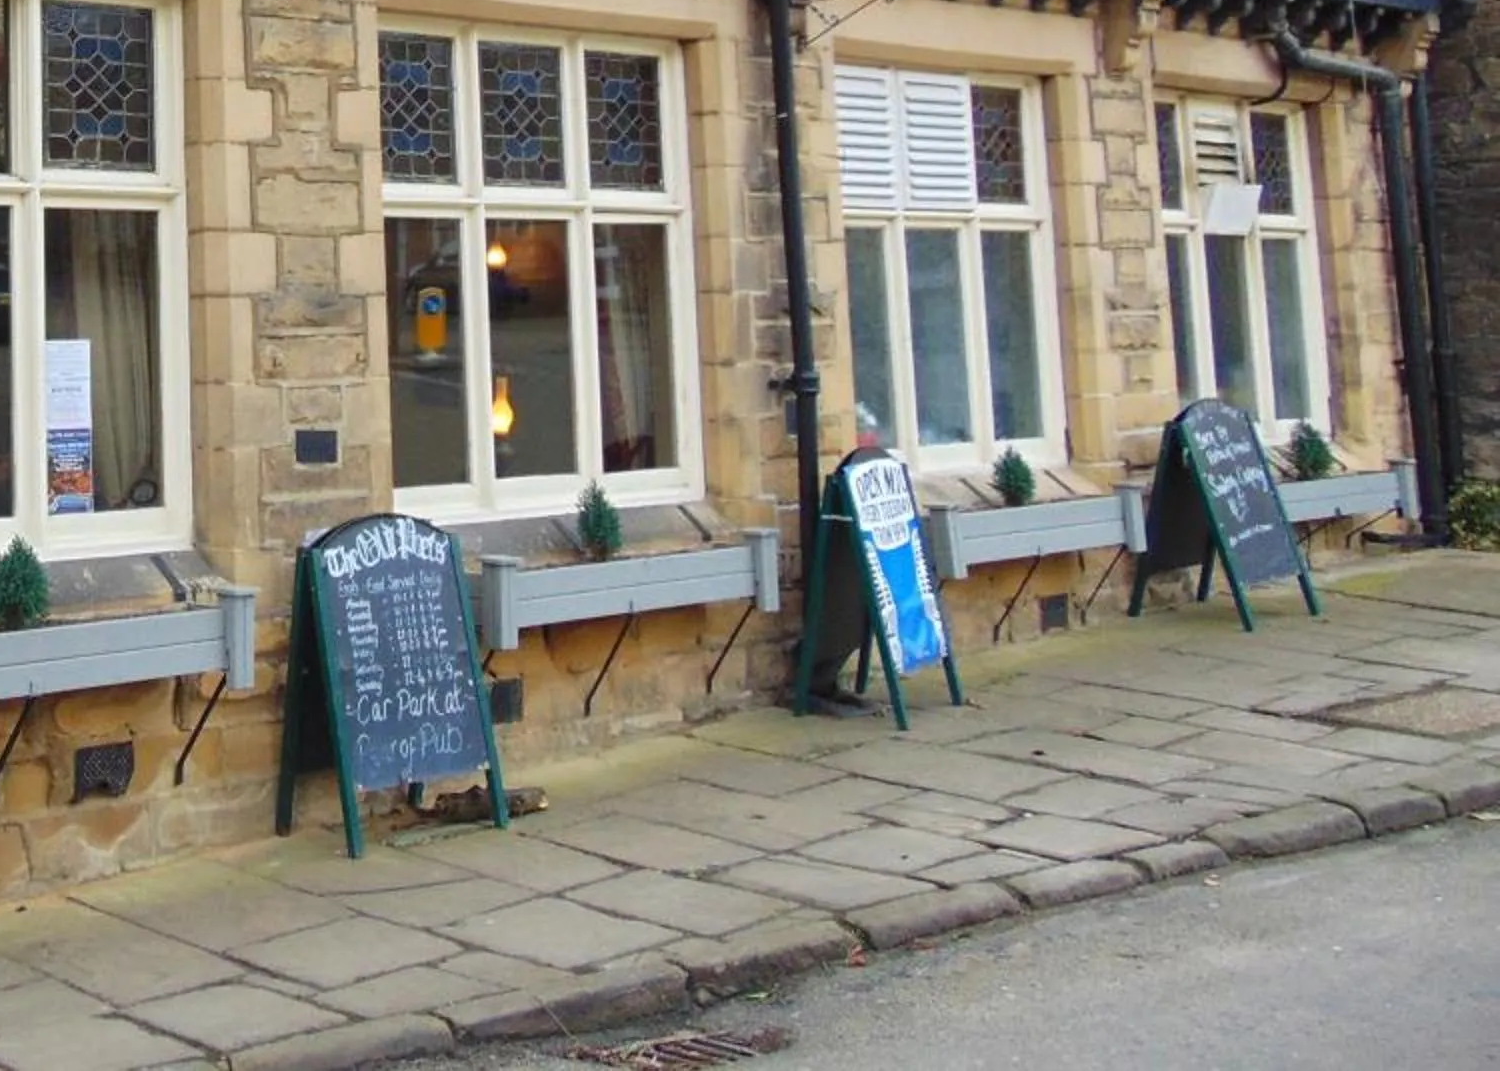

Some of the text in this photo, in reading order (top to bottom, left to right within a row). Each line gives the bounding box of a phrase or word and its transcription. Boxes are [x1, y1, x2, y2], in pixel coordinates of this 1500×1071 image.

[856, 465, 884, 503] OPEN
[323, 518, 449, 578] The Old Poets
[356, 685, 466, 727] Car Park at
[399, 736, 417, 769] of
[419, 722, 464, 760] Pub
